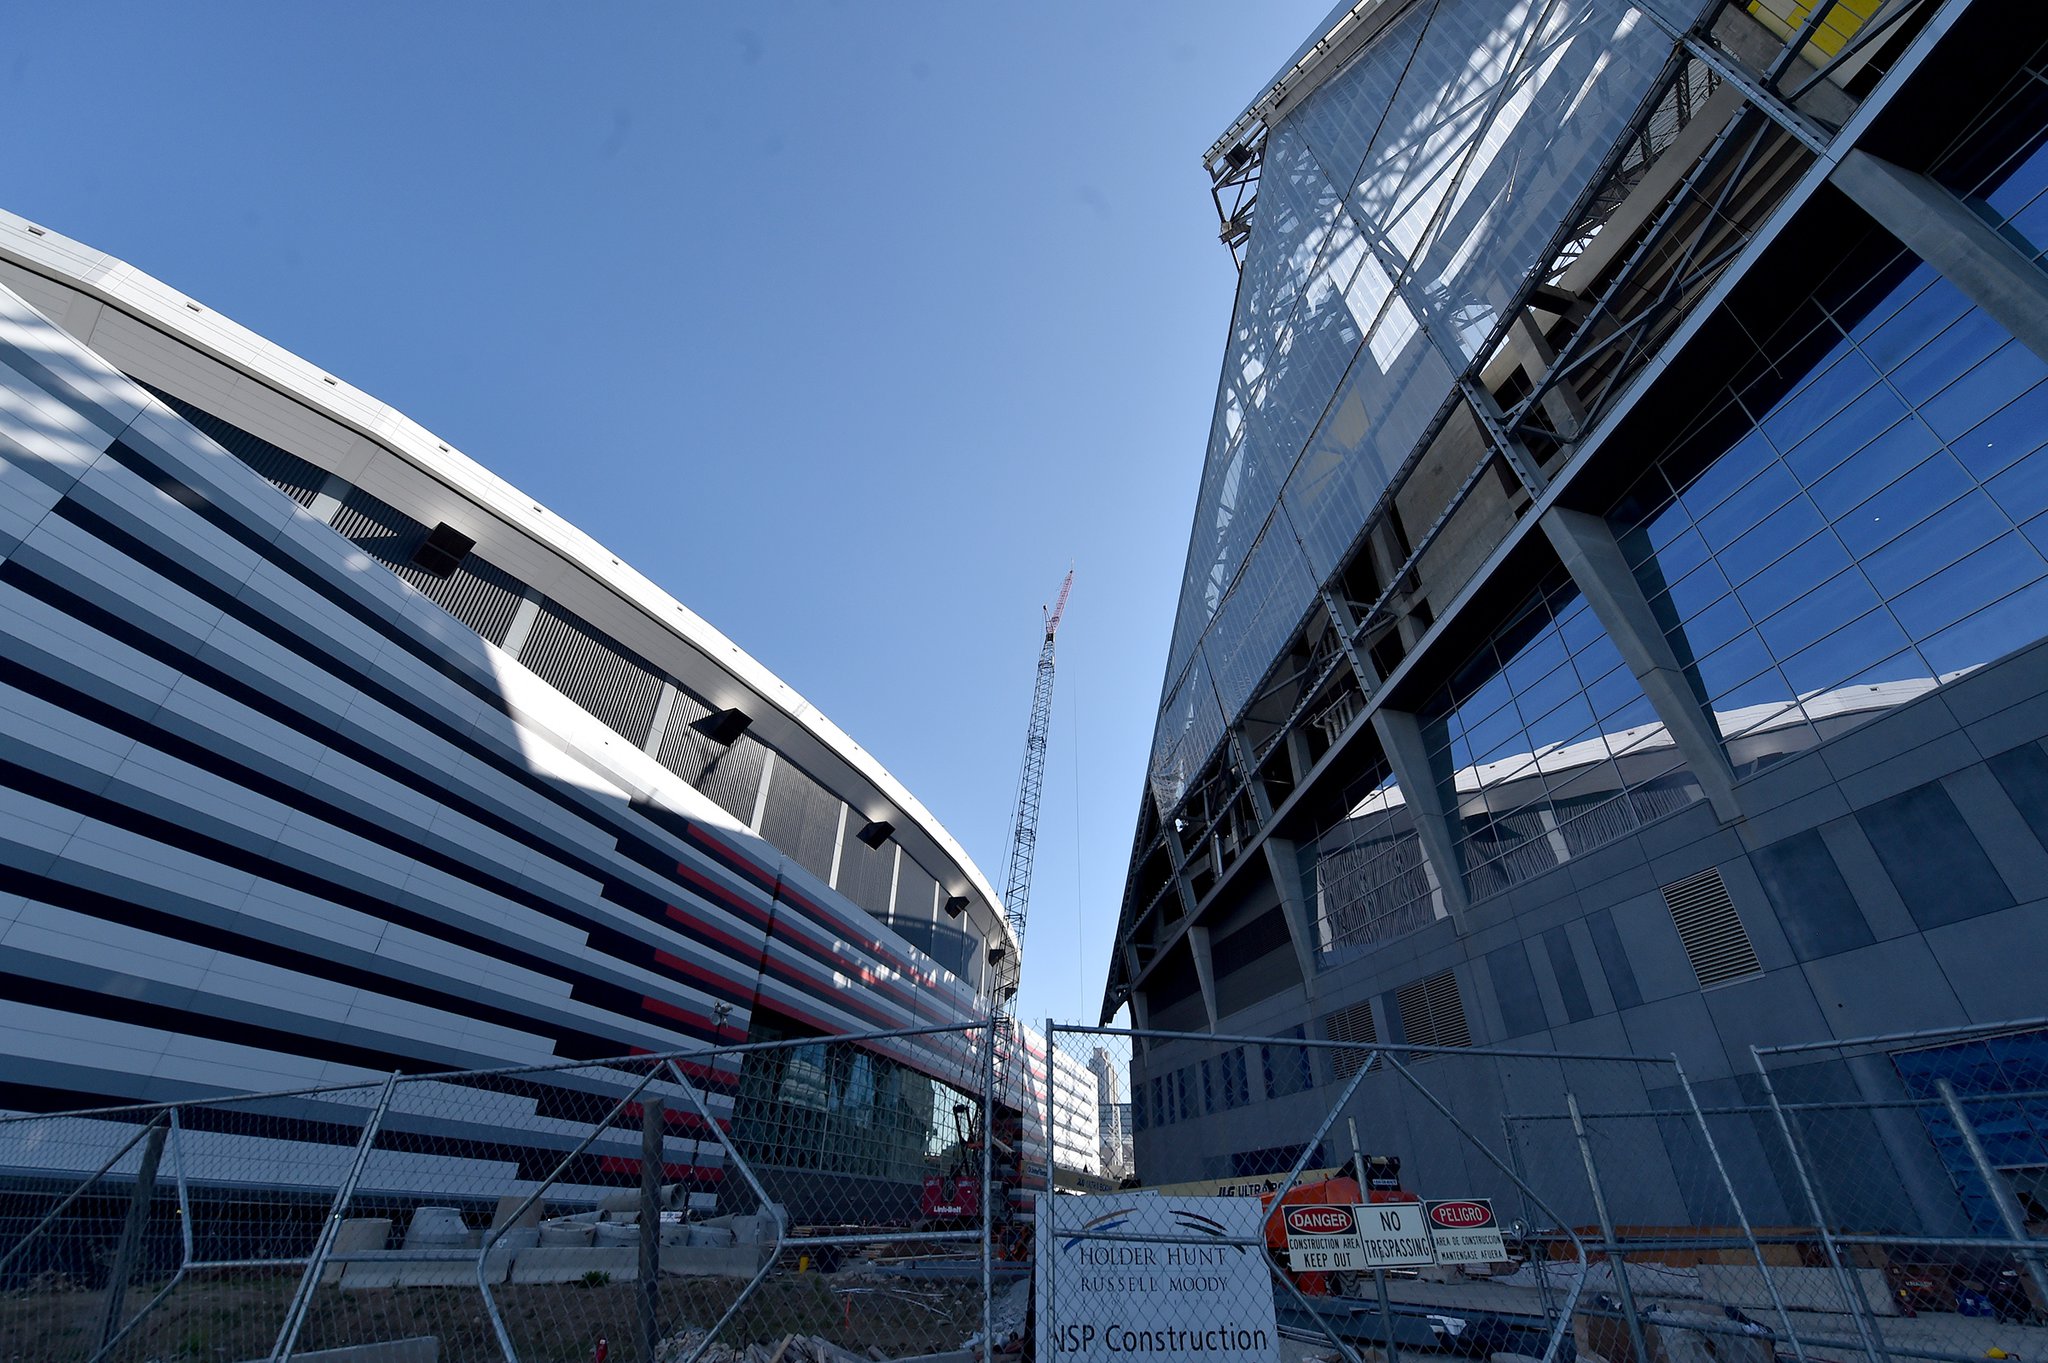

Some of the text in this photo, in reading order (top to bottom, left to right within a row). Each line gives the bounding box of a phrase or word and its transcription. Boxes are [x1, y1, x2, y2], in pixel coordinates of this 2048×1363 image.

[1217, 1186, 1236, 1197] JLG
[1294, 1213, 1348, 1227] DANGER
[1380, 1211, 1401, 1232] NO
[1439, 1207, 1483, 1222] PELIGRO
[1290, 1238, 1360, 1250] CONSTRUCTION AREA
[1365, 1238, 1429, 1259] TRESPASSING
[1436, 1236, 1451, 1246] AREA
[1452, 1236, 1460, 1246] DE
[1080, 1247, 1225, 1265] HOLDER HUNT
[1304, 1252, 1352, 1268] KEEP OUT
[1441, 1249, 1502, 1261] MANTENGASE AFUERA
[1081, 1276, 1228, 1292] RUSSELL MOODY
[1055, 1321, 1268, 1353] NSP Construction
